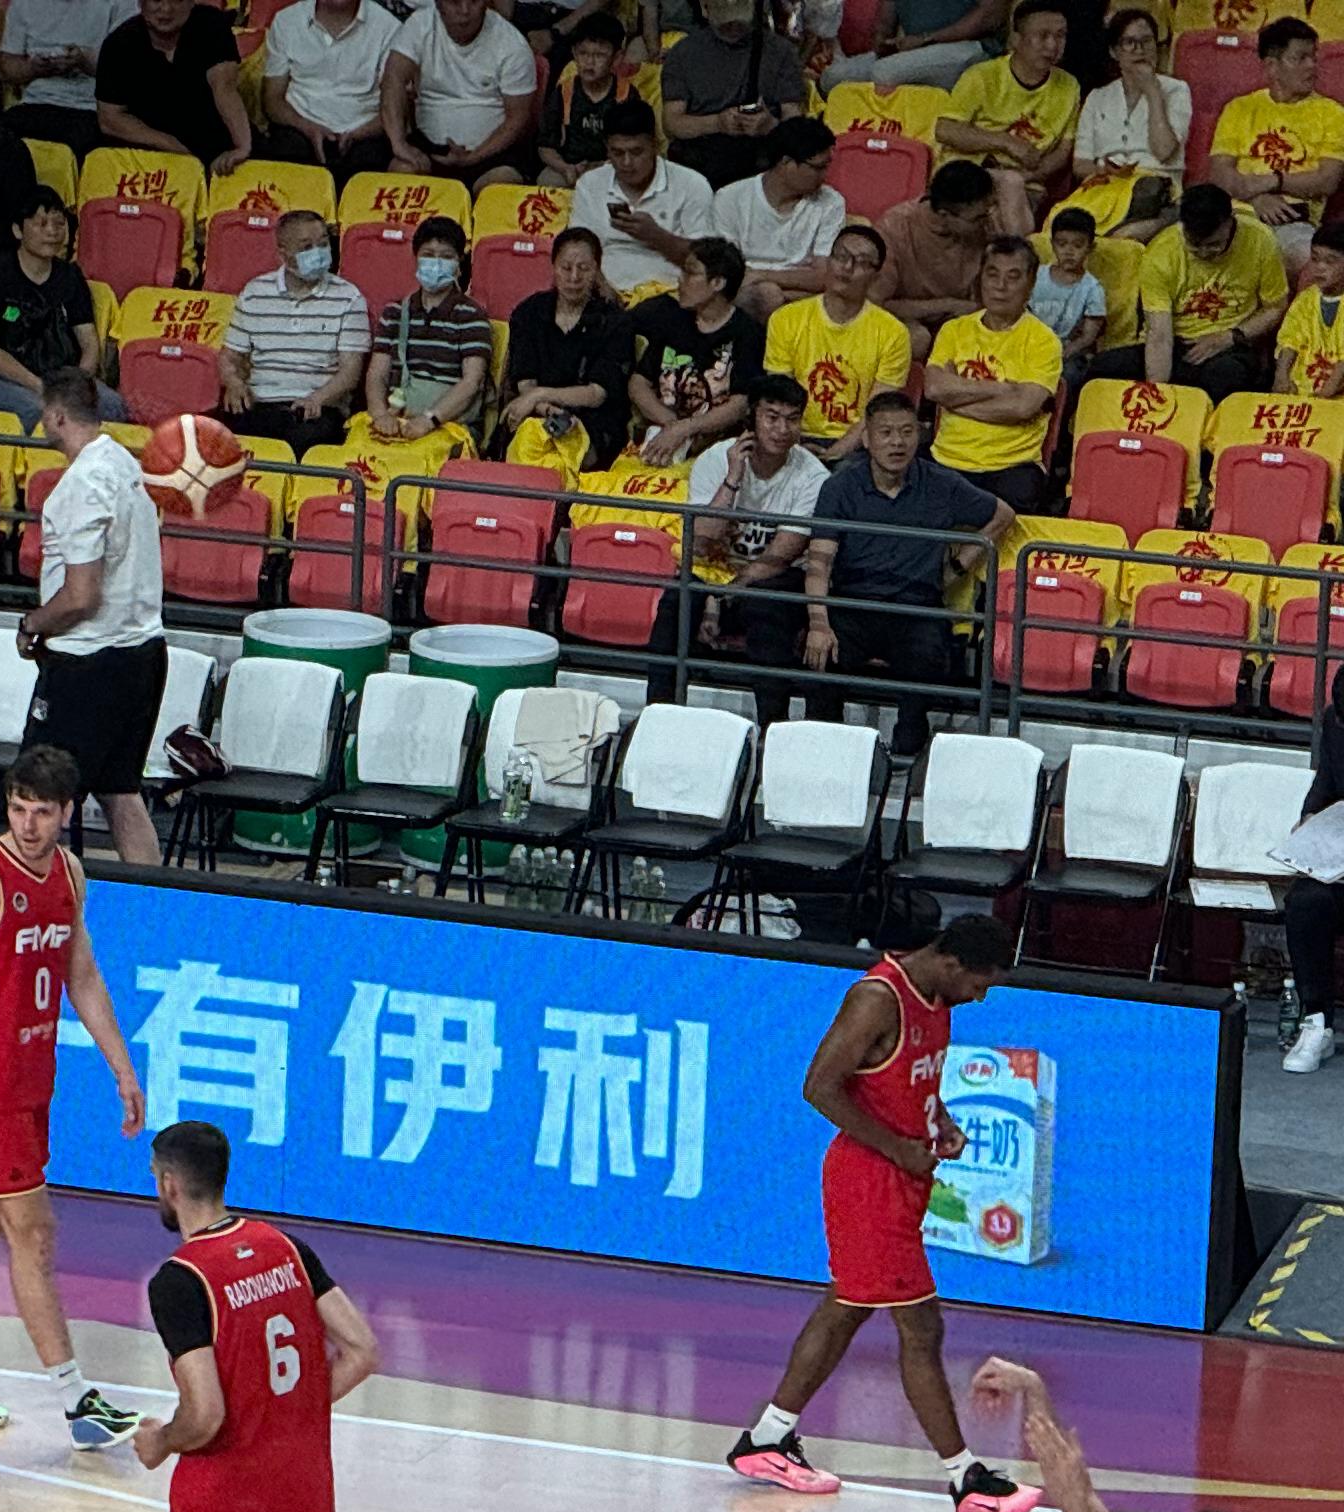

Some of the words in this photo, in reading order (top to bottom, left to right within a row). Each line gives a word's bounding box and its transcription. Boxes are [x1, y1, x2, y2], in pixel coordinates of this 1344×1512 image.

[1252, 402, 1313, 429] 长沙
[15, 923, 71, 954] FMP
[35, 967, 51, 1011] 0
[224, 1257, 302, 1310] RADOVANOVIĆ
[265, 1313, 301, 1396] 6
